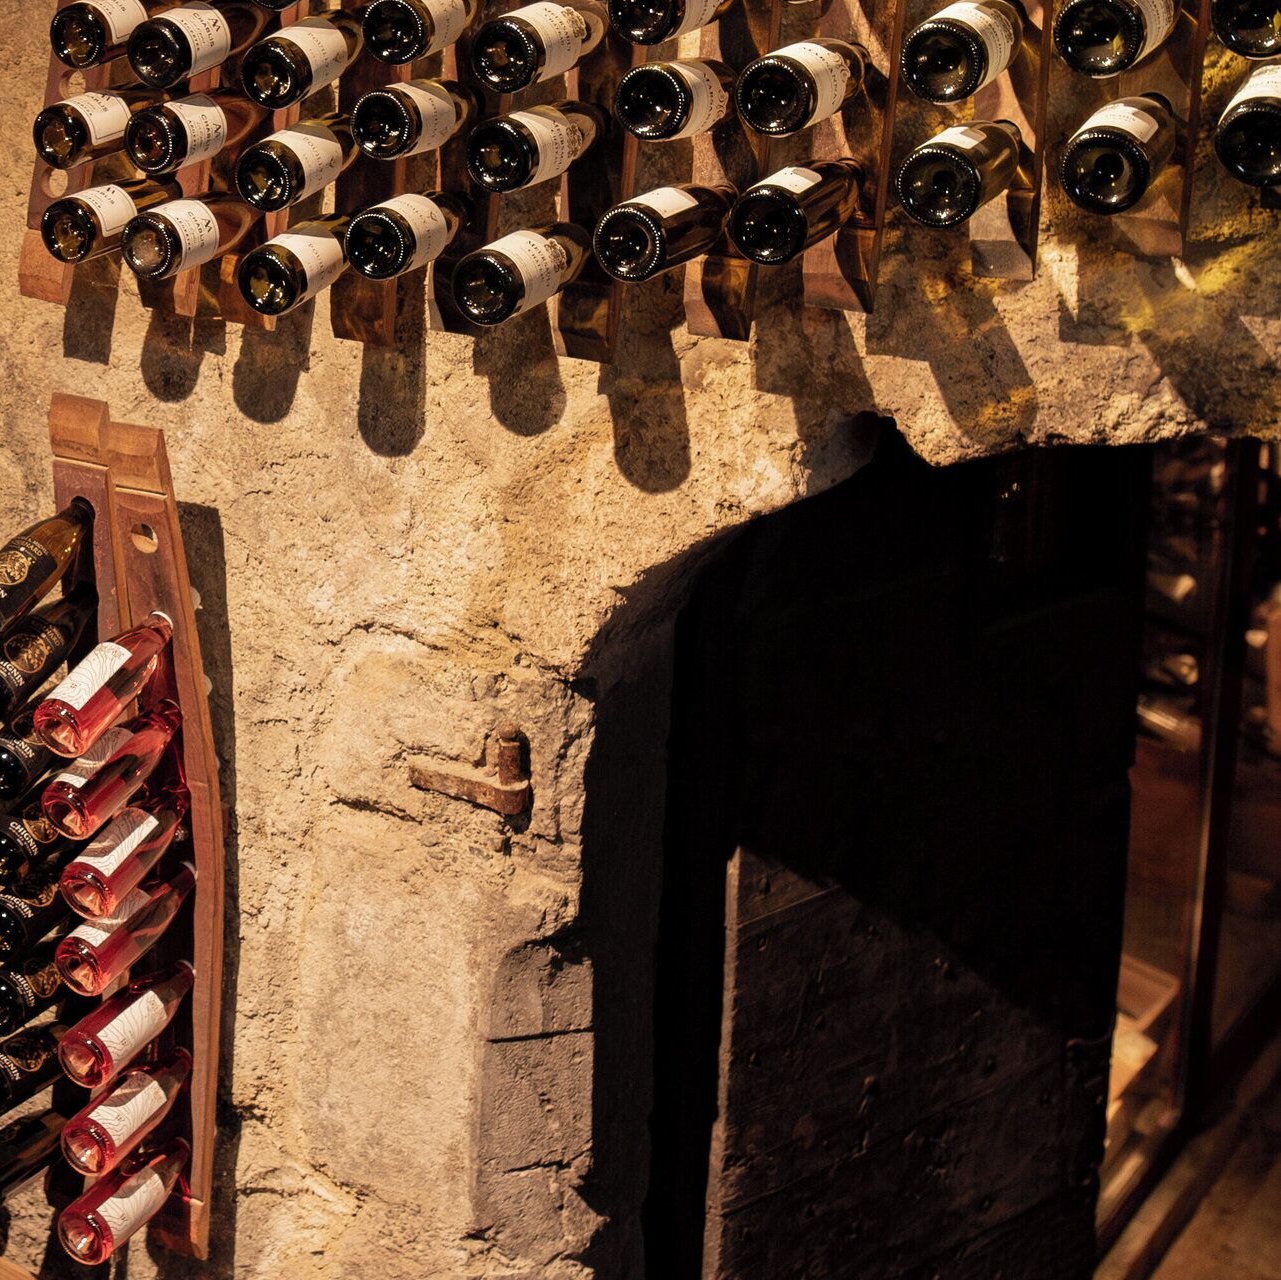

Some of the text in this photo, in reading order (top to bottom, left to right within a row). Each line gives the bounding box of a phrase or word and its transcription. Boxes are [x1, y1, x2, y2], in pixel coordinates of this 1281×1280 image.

[192, 9, 216, 48] CHABLIS
[199, 111, 214, 152] CHABLIS
[185, 208, 206, 249] CHABLIS
[9, 819, 40, 857] CHIGNIN
